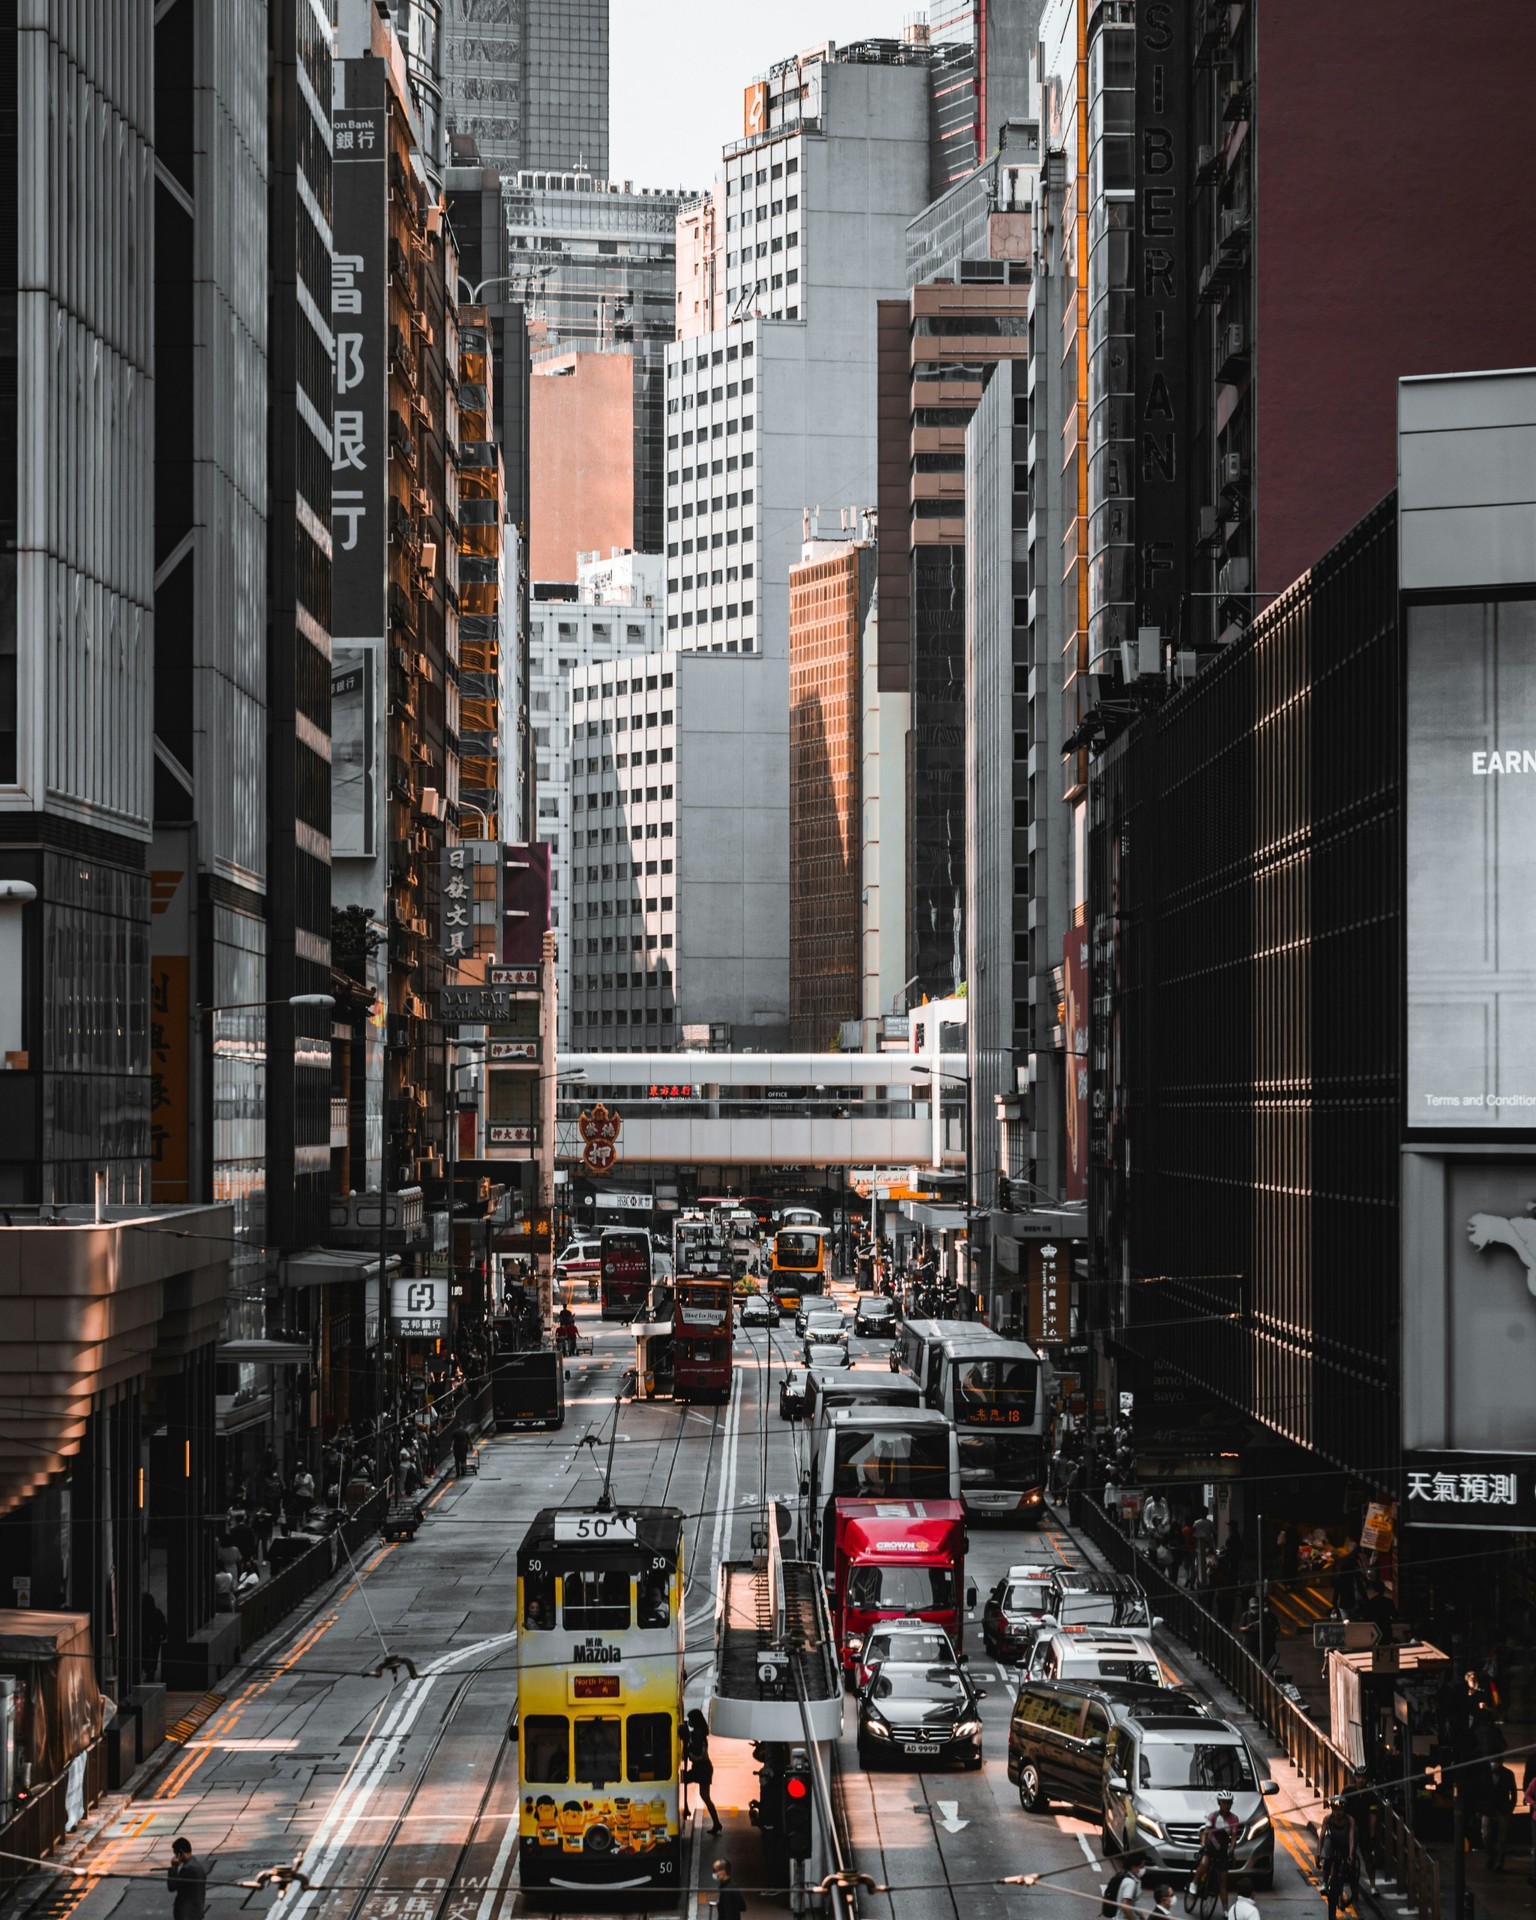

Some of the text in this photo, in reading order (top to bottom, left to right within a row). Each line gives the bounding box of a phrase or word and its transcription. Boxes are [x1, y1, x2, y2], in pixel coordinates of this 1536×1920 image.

[348, 120, 374, 129] Bank
[335, 131, 375, 149] 銀行
[444, 850, 470, 957] 日發文具
[444, 991, 471, 1005] YAT
[442, 1007, 510, 1020] STATIONERS
[1424, 1094, 1460, 1106] Terms
[1462, 1094, 1484, 1106] and
[588, 1143, 612, 1166] 押
[400, 1319, 441, 1329] 富邦銀行
[1008, 1410, 1020, 1422] 18
[1408, 1472, 1517, 1504] 天氣預測
[576, 1519, 607, 1537] 50
[876, 1541, 915, 1549] CROWN
[529, 1557, 666, 1571] 50 50
[573, 1645, 621, 1664] Mazola
[576, 1677, 617, 1686] North Point
[659, 1861, 672, 1873] 50
